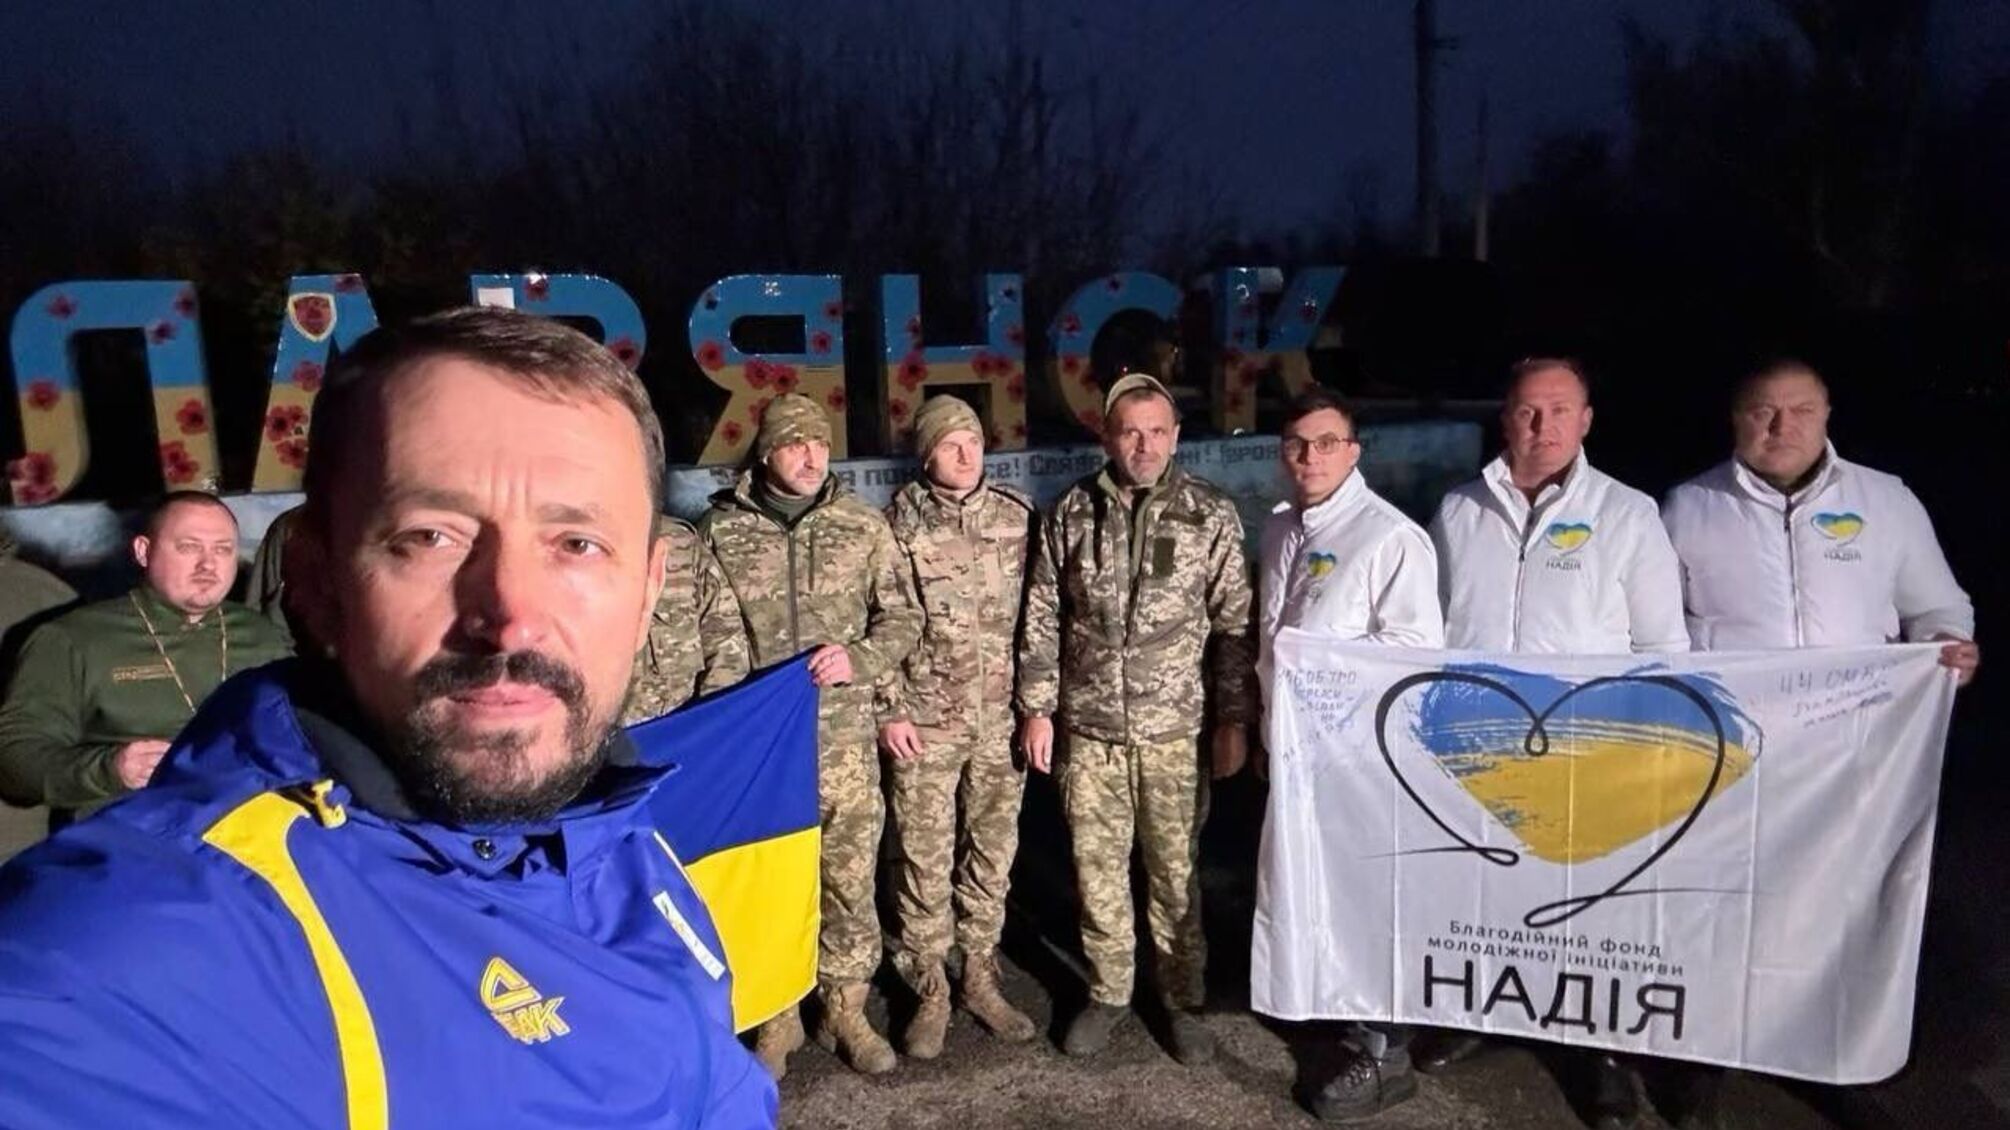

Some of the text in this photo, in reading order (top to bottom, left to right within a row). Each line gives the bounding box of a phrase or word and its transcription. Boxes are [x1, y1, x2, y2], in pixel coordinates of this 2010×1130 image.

[1427, 936, 1684, 977] молодіжної ініціативи
[1449, 920, 1662, 959] Благодійний фонд
[1423, 954, 1686, 1041] НАДІЯ
